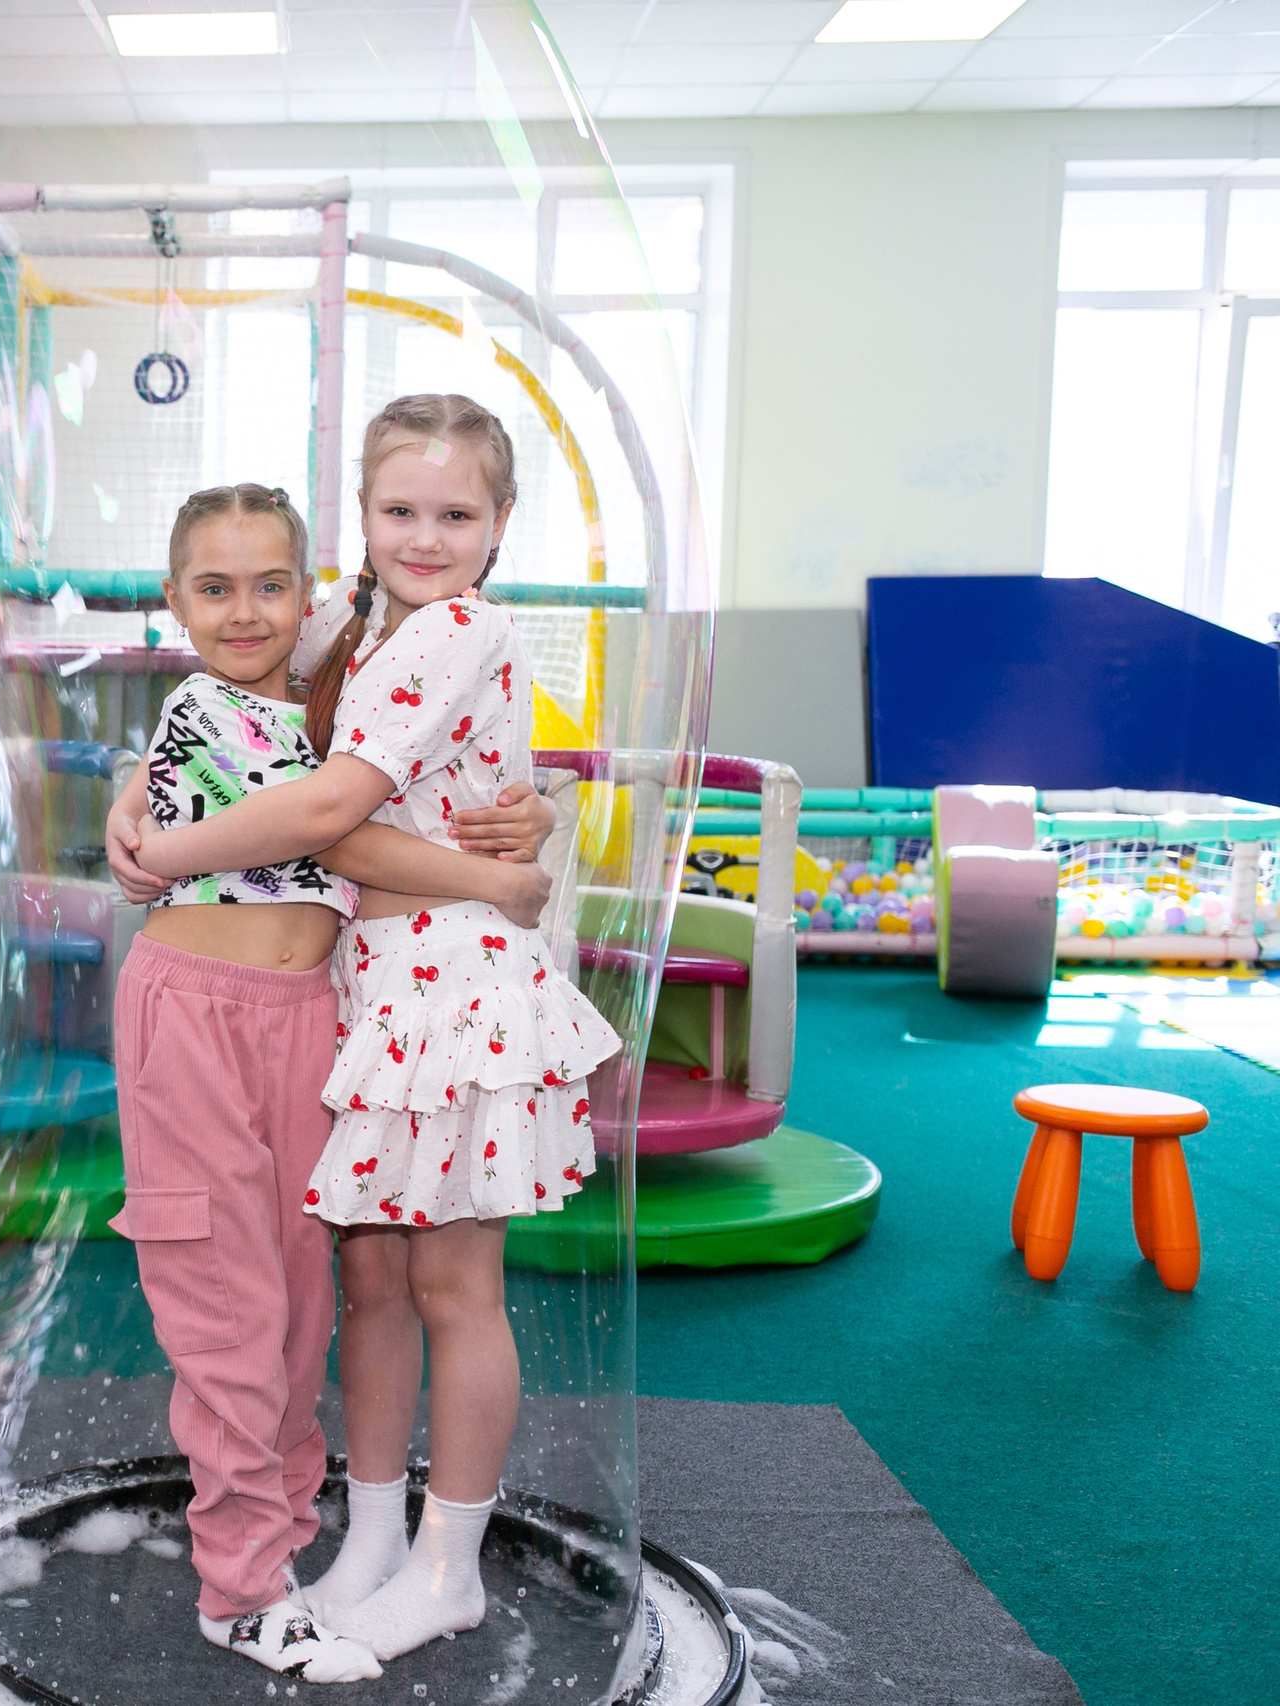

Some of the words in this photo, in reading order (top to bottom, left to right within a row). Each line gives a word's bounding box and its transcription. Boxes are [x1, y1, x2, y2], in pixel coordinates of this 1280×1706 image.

[182, 691, 201, 713] MAKE
[197, 712, 222, 739] TODAY
[197, 769, 231, 806] GREAT
[243, 867, 282, 893] VIBES
